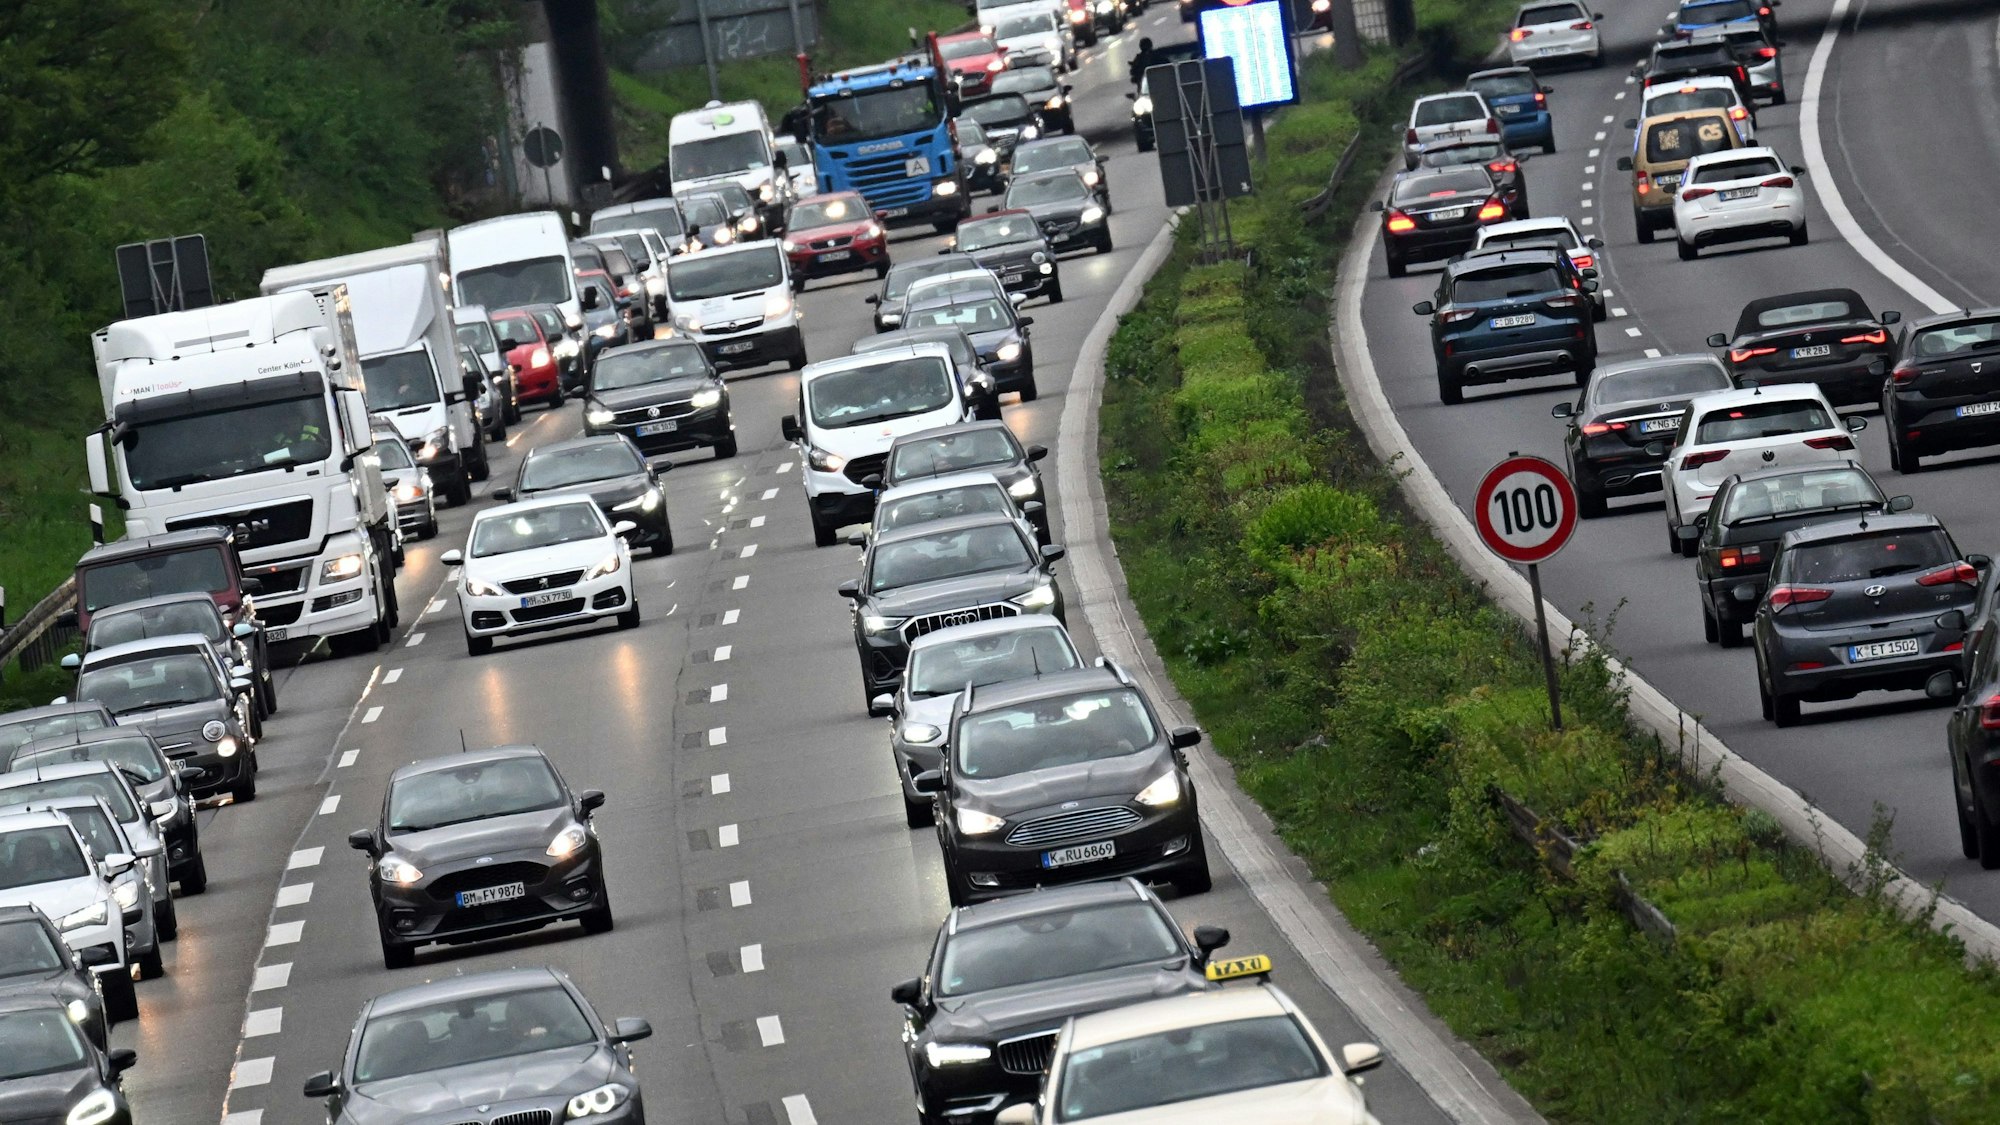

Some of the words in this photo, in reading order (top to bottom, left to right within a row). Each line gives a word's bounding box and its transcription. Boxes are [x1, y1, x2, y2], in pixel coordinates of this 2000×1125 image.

[1516, 315, 1534, 324] 9289
[1813, 346, 1829, 355] 283
[257, 366, 282, 374] Center
[284, 361, 301, 369] Köln
[133, 386, 151, 395] MAN
[1961, 405, 1976, 415] LEV
[1657, 420, 1670, 429] NG
[1494, 484, 1558, 535] 100
[552, 590, 571, 602] 7730
[1855, 647, 1864, 658] K
[1871, 643, 1886, 656] ET
[1888, 640, 1917, 653] 1502
[1065, 848, 1082, 861] RU
[1083, 843, 1113, 858] 6869
[463, 891, 477, 904] BM
[483, 889, 496, 901] FY
[498, 884, 524, 898] 9876
[1214, 957, 1262, 977] TAXI
